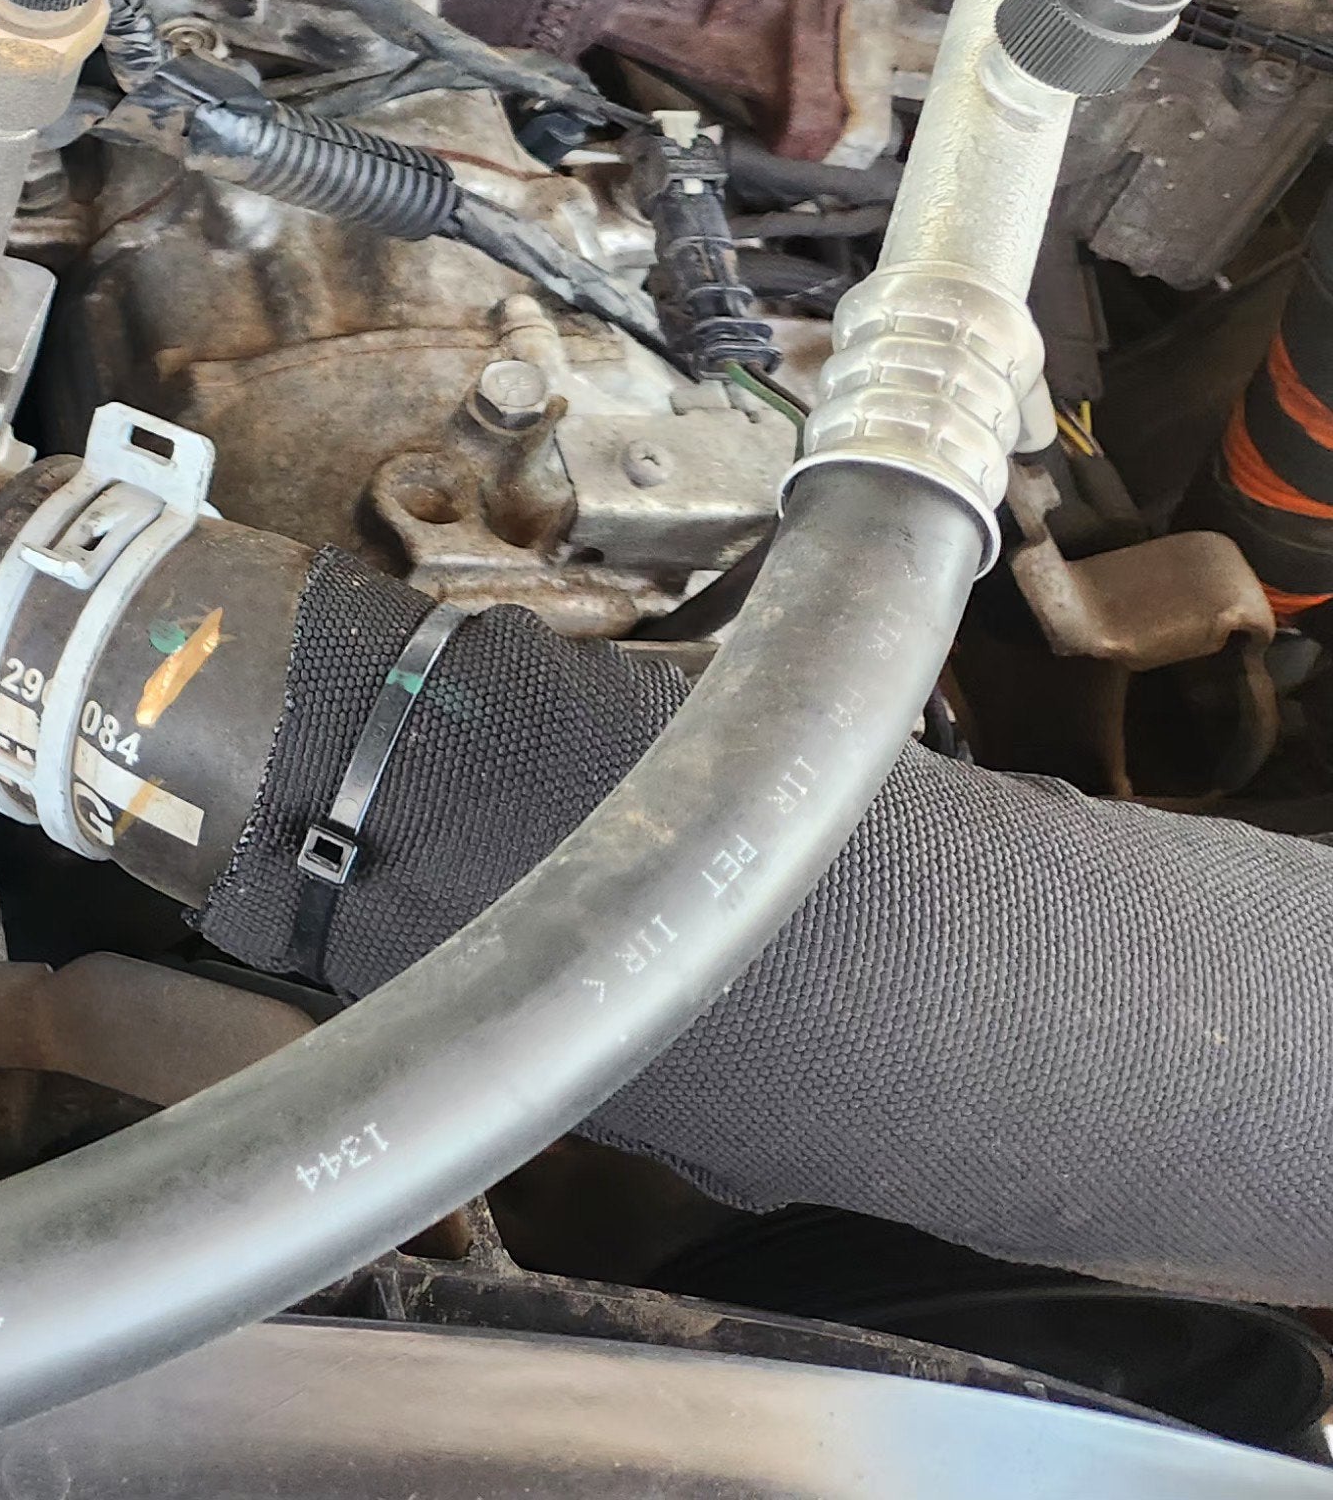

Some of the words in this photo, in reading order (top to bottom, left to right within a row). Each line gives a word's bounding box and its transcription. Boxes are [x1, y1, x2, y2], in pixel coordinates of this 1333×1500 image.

[765, 754, 821, 818] IIR
[702, 833, 758, 899] PET
[616, 912, 679, 975] IIR
[295, 1121, 390, 1193] 1344
